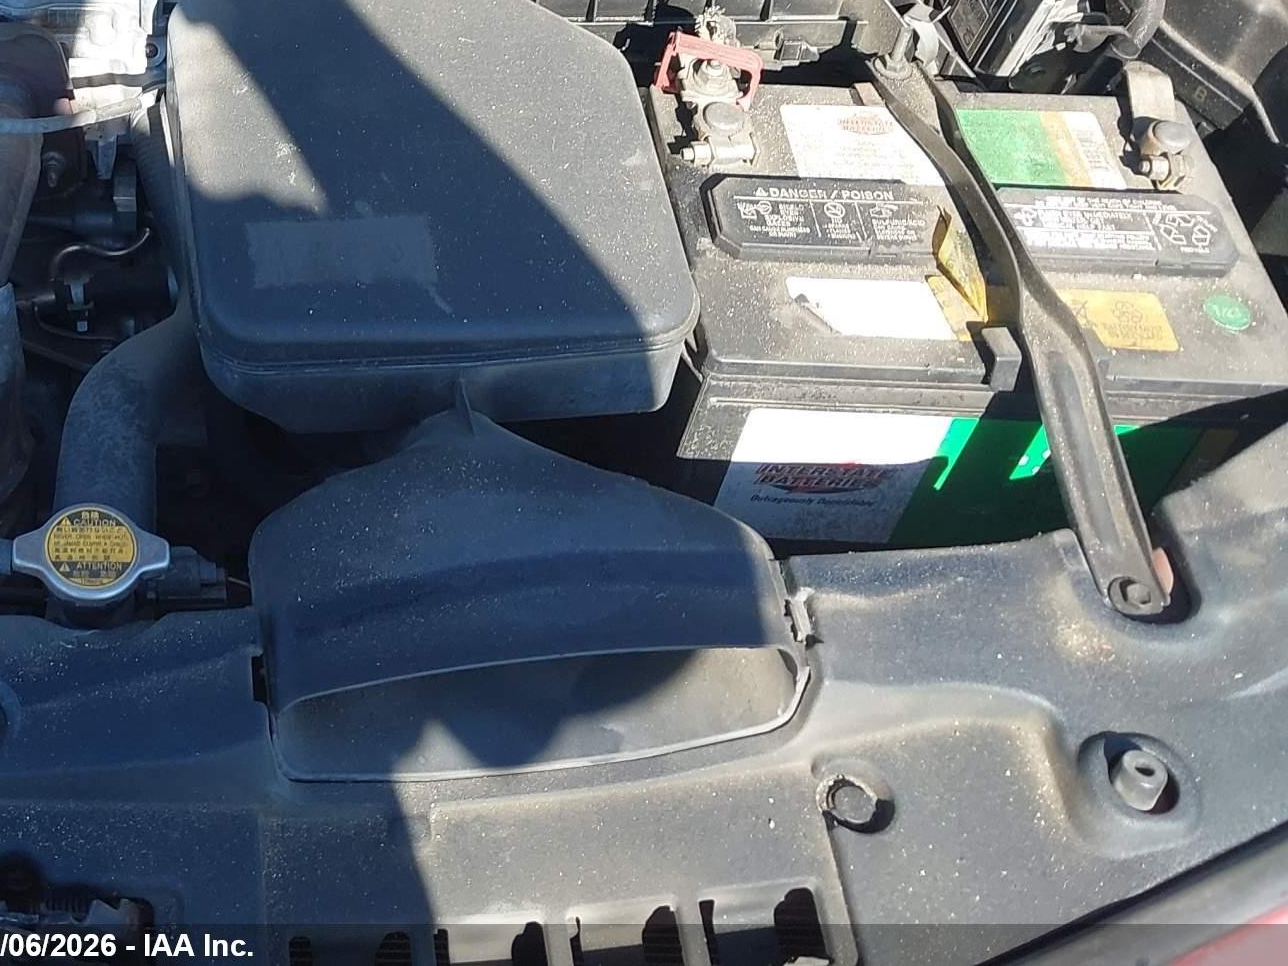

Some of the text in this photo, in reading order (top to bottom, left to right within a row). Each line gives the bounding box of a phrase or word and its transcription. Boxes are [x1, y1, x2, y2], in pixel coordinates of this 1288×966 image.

[769, 187, 827, 199] DANGER
[841, 190, 894, 200] POISON
[73, 518, 116, 527] CAUTION
[76, 562, 122, 571] ATTENTION
